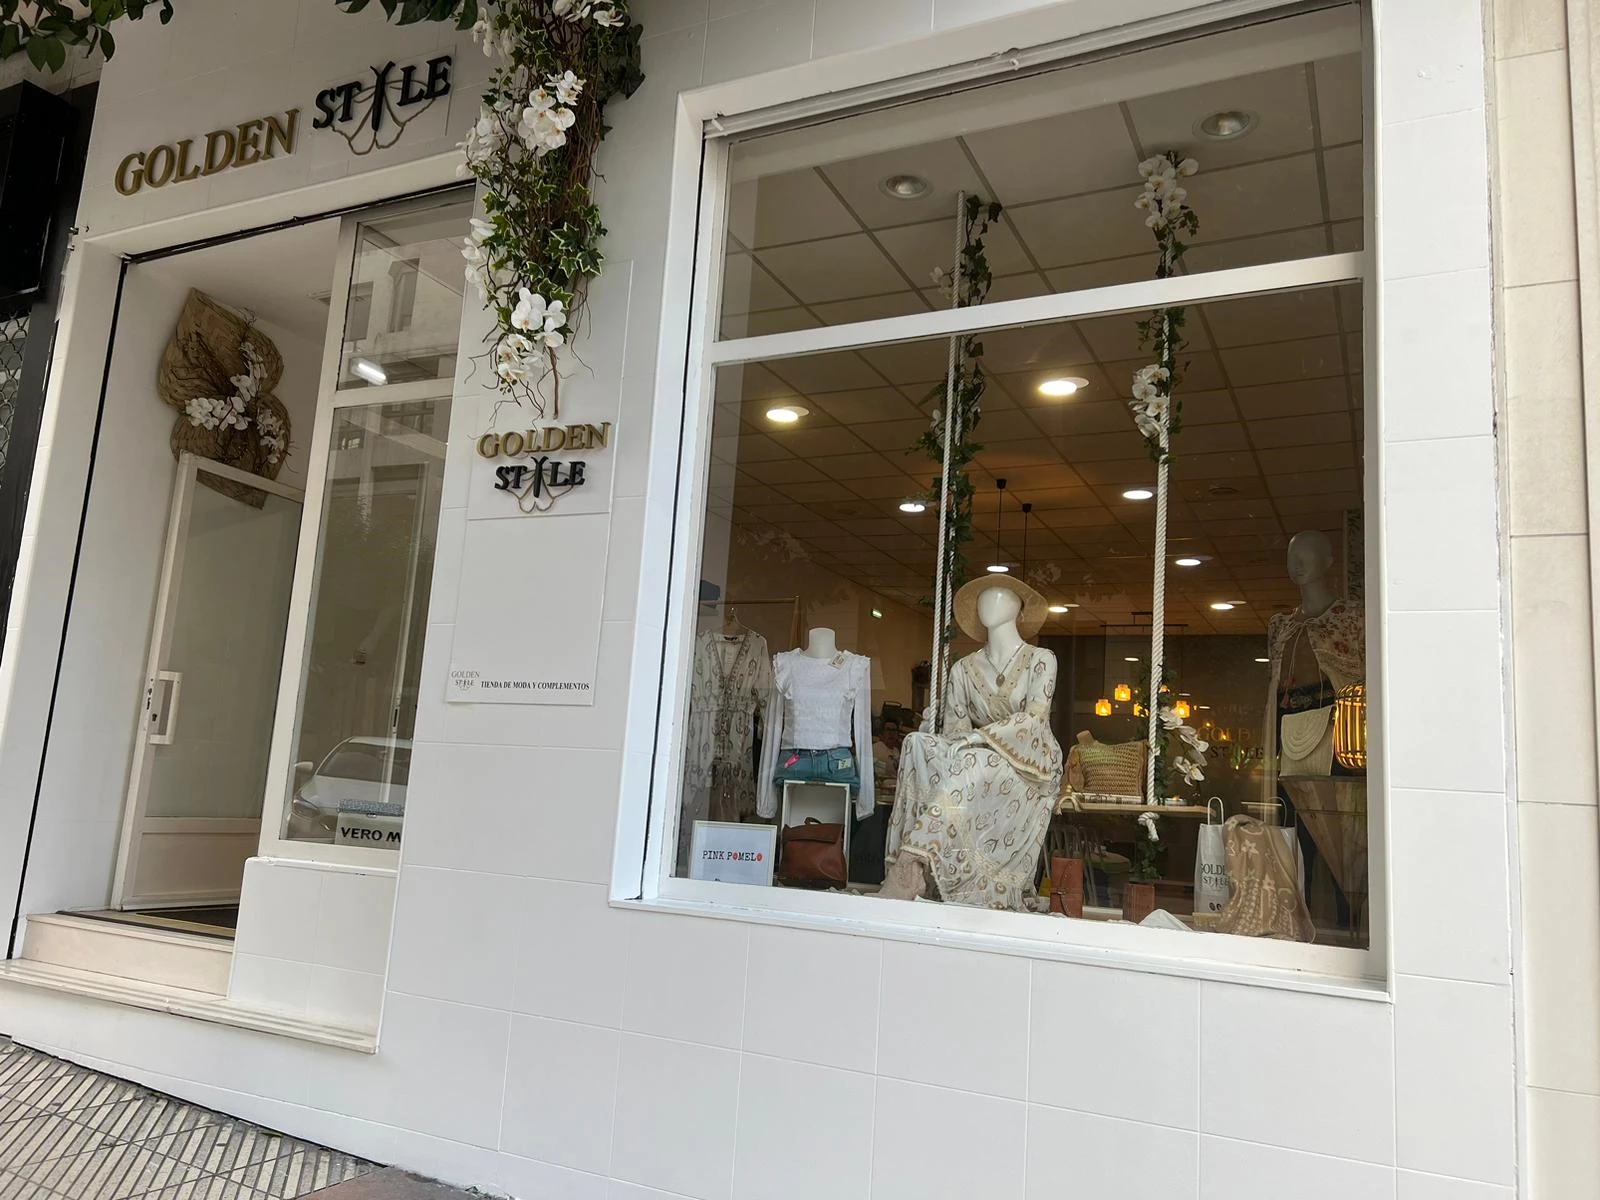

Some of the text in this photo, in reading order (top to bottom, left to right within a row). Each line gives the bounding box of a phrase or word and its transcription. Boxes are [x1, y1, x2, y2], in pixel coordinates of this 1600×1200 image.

[114, 55, 452, 196] GOLDEN STYLE
[476, 421, 611, 458] GOLDEN
[494, 455, 586, 498] STYLE
[451, 670, 480, 679] GOLDEN
[480, 680, 590, 691] TIENDA DE MODA Y COMPLEMENTOS
[341, 826, 383, 841] VERO
[702, 850, 763, 862] PINK POMELO
